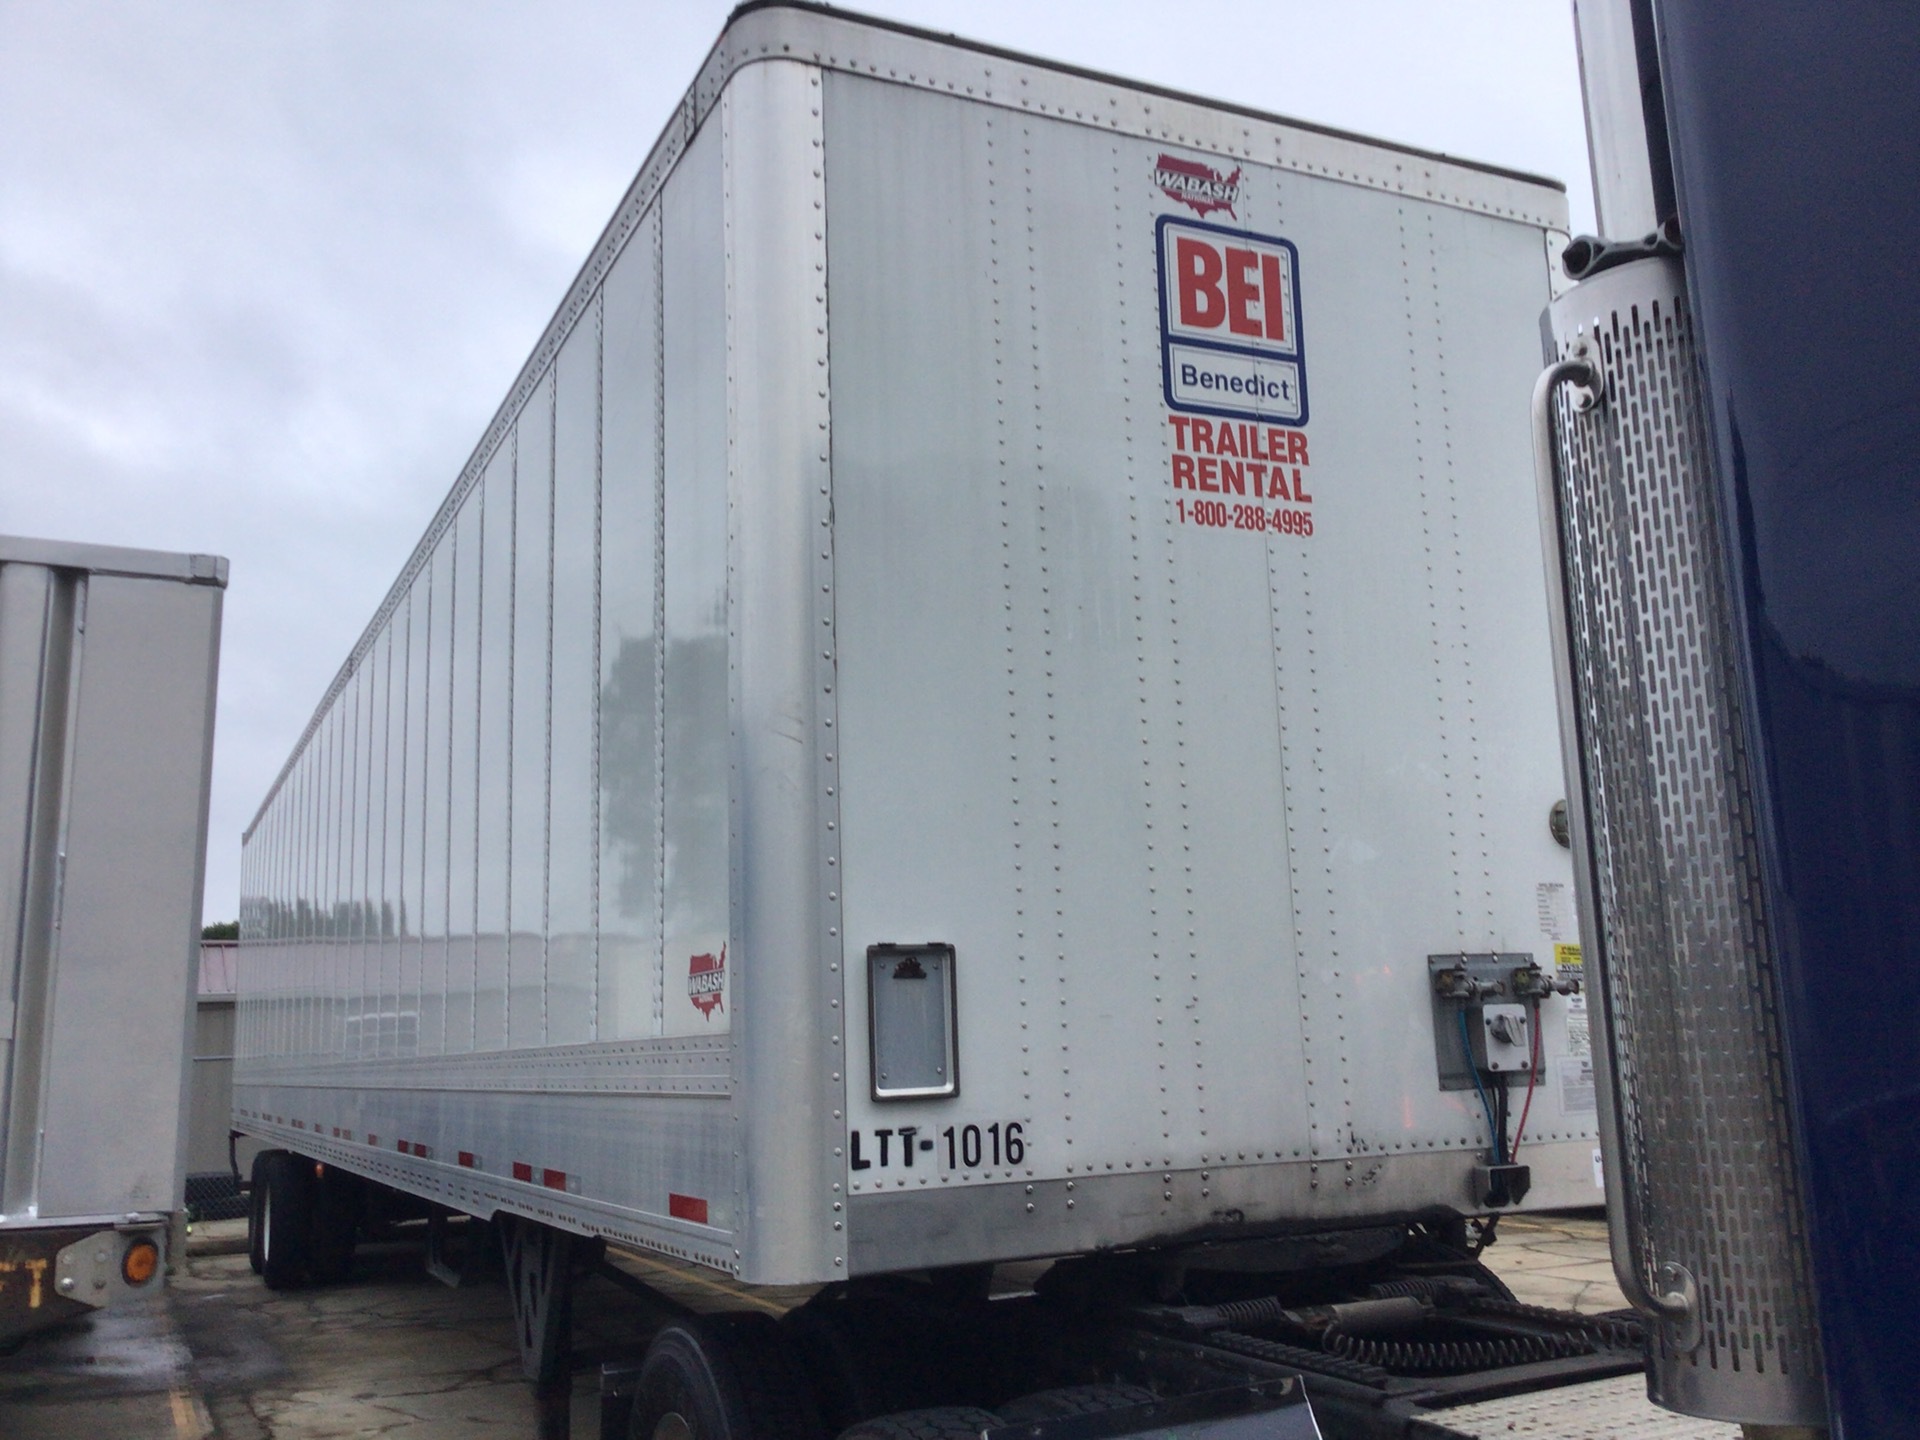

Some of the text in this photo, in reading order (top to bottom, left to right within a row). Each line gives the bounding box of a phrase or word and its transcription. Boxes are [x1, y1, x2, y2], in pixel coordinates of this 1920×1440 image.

[1154, 169, 1239, 203] WABASH
[1176, 236, 1284, 341] BEI
[1181, 363, 1290, 400] Benedict
[1168, 415, 1310, 466] TRAILER
[1171, 455, 1312, 503] RENTAL
[1175, 500, 1313, 537] 1-800-288-4995
[688, 969, 725, 997] WABASH
[851, 1122, 1024, 1171] LTT-1016
